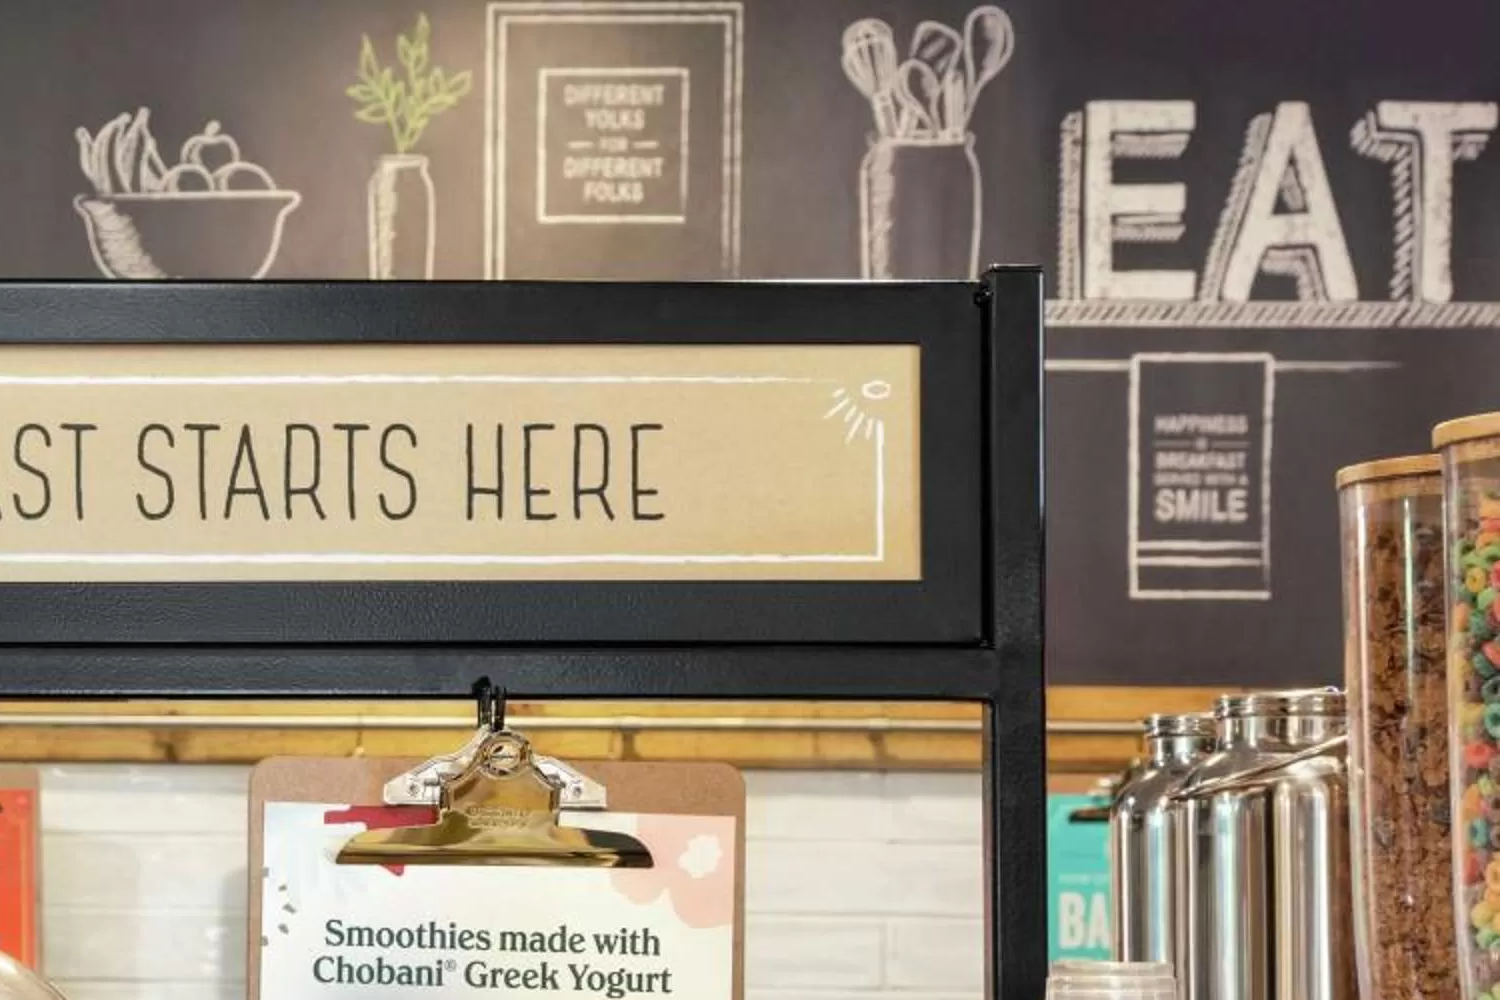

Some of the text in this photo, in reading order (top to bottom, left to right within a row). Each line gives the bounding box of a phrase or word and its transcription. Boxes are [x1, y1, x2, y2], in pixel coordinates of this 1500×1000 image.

[564, 84, 665, 106] DIFFERENT
[584, 108, 645, 130] YOLKS
[563, 156, 665, 179] DIFFERENT
[583, 181, 645, 204] FOLKS
[1066, 99, 1498, 303] EAT
[135, 423, 418, 520] STARTS
[466, 423, 665, 520] HERE
[1155, 488, 1248, 522] SMILE
[324, 919, 662, 956] Smoothies made with
[1059, 891, 1110, 950] BA
[463, 961, 560, 991] Greek
[567, 963, 673, 999] Yogurt
